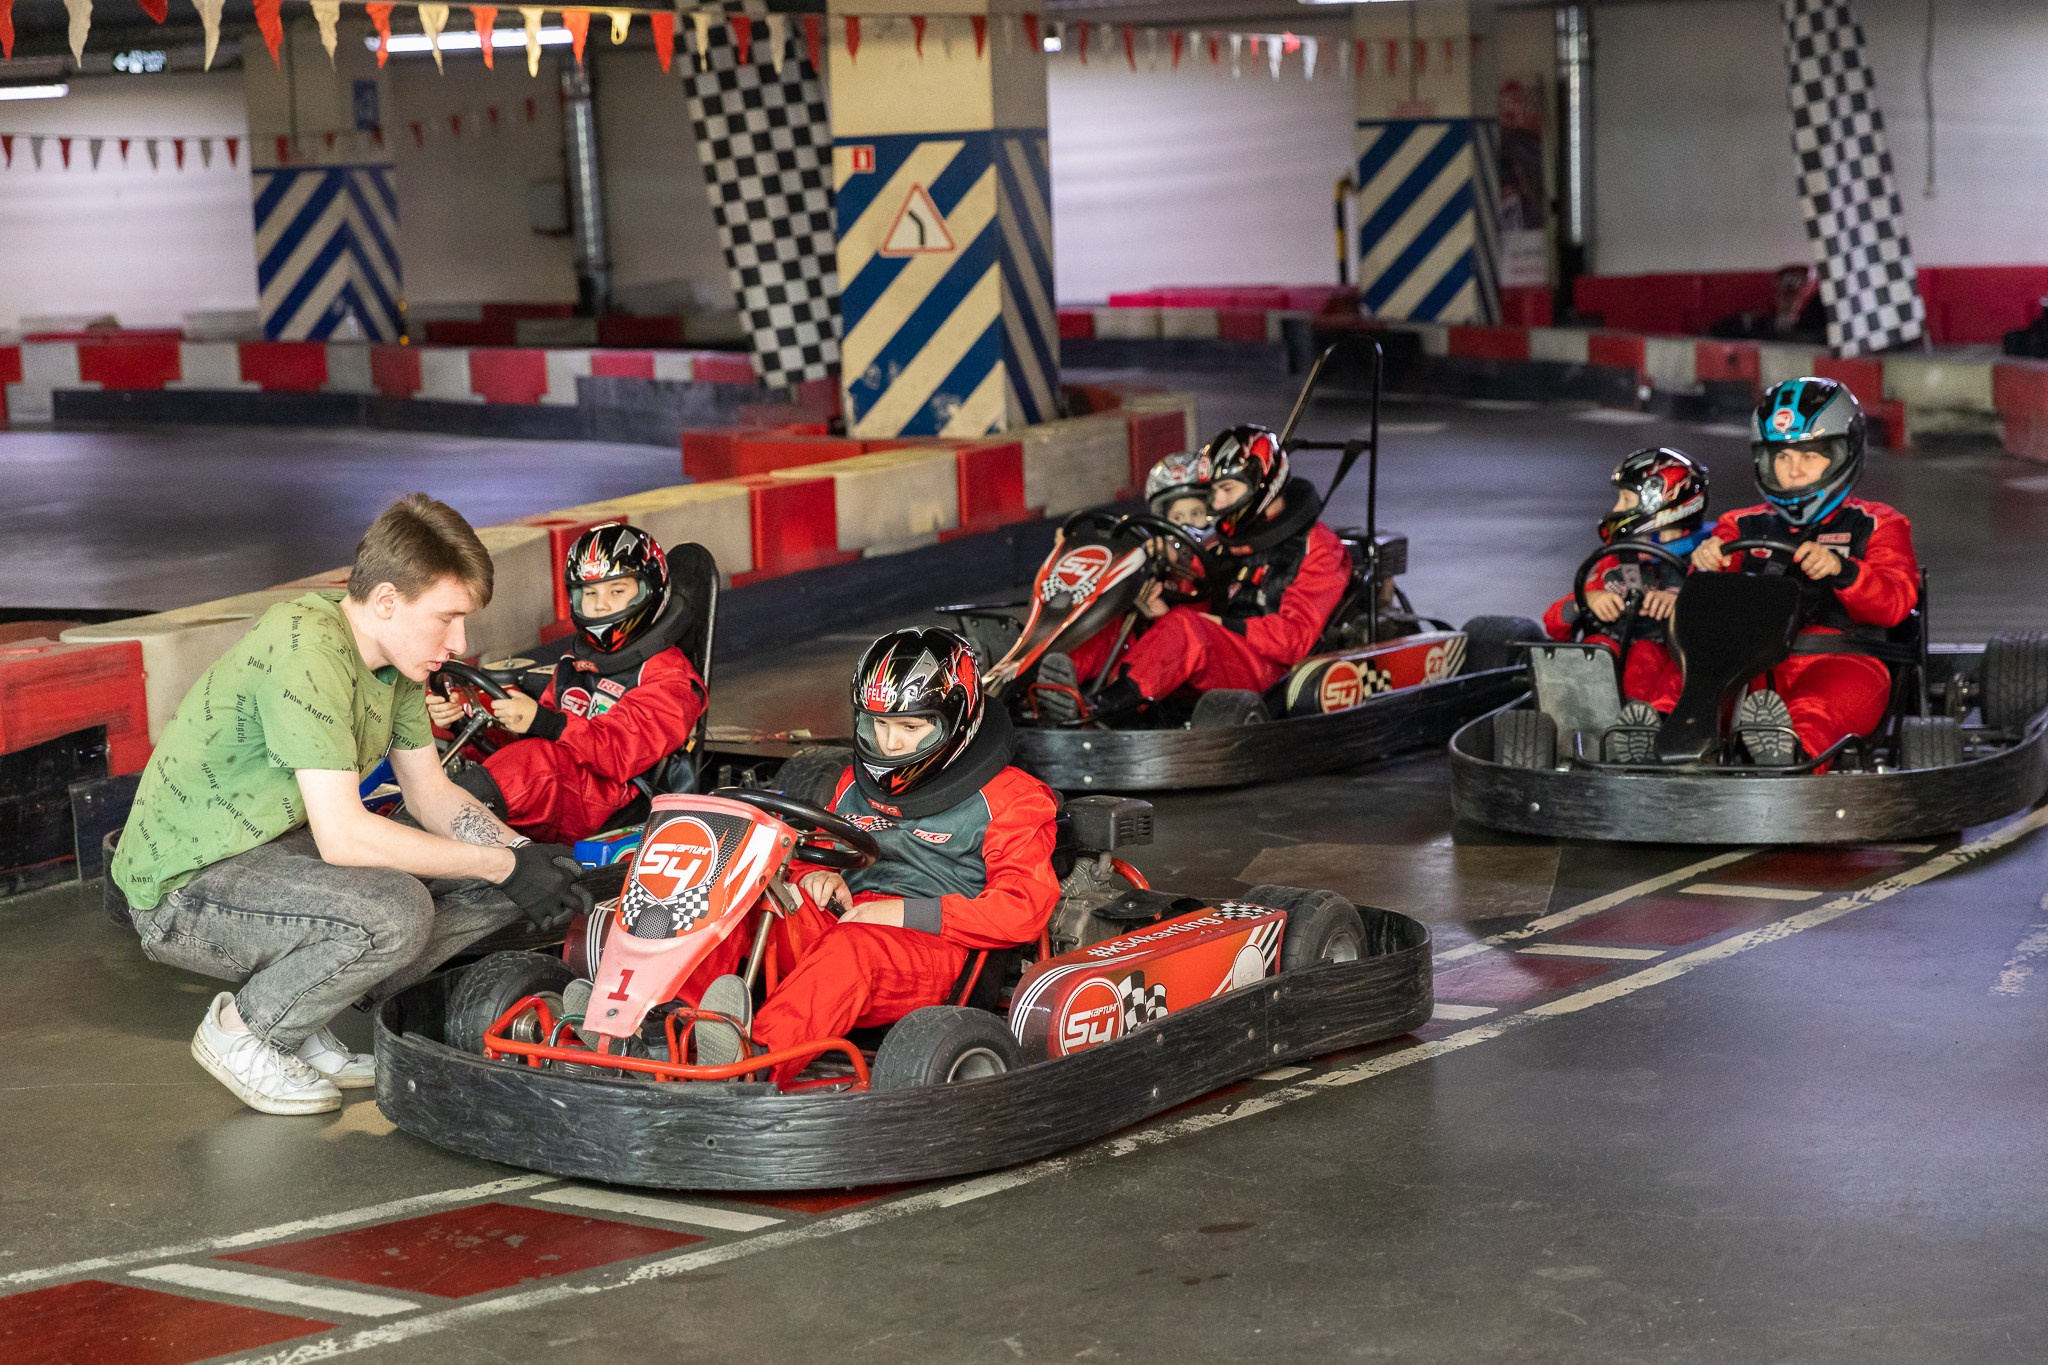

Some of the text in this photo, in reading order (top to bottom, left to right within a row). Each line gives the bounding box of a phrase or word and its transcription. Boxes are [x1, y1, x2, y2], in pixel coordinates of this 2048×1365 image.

[247, 655, 265, 671] Palm
[1429, 656, 1444, 674] 27
[283, 688, 335, 725] Palm Angels
[1325, 682, 1357, 707] 54
[235, 716, 248, 744] Angels
[201, 761, 222, 791] Angels
[169, 782, 188, 804] Palm
[242, 818, 264, 840] Palm
[916, 831, 948, 842] RLG
[638, 842, 703, 896] 54
[1087, 916, 1224, 958] #k54karting
[607, 969, 635, 1002] 1
[1064, 1009, 1115, 1049] 54
